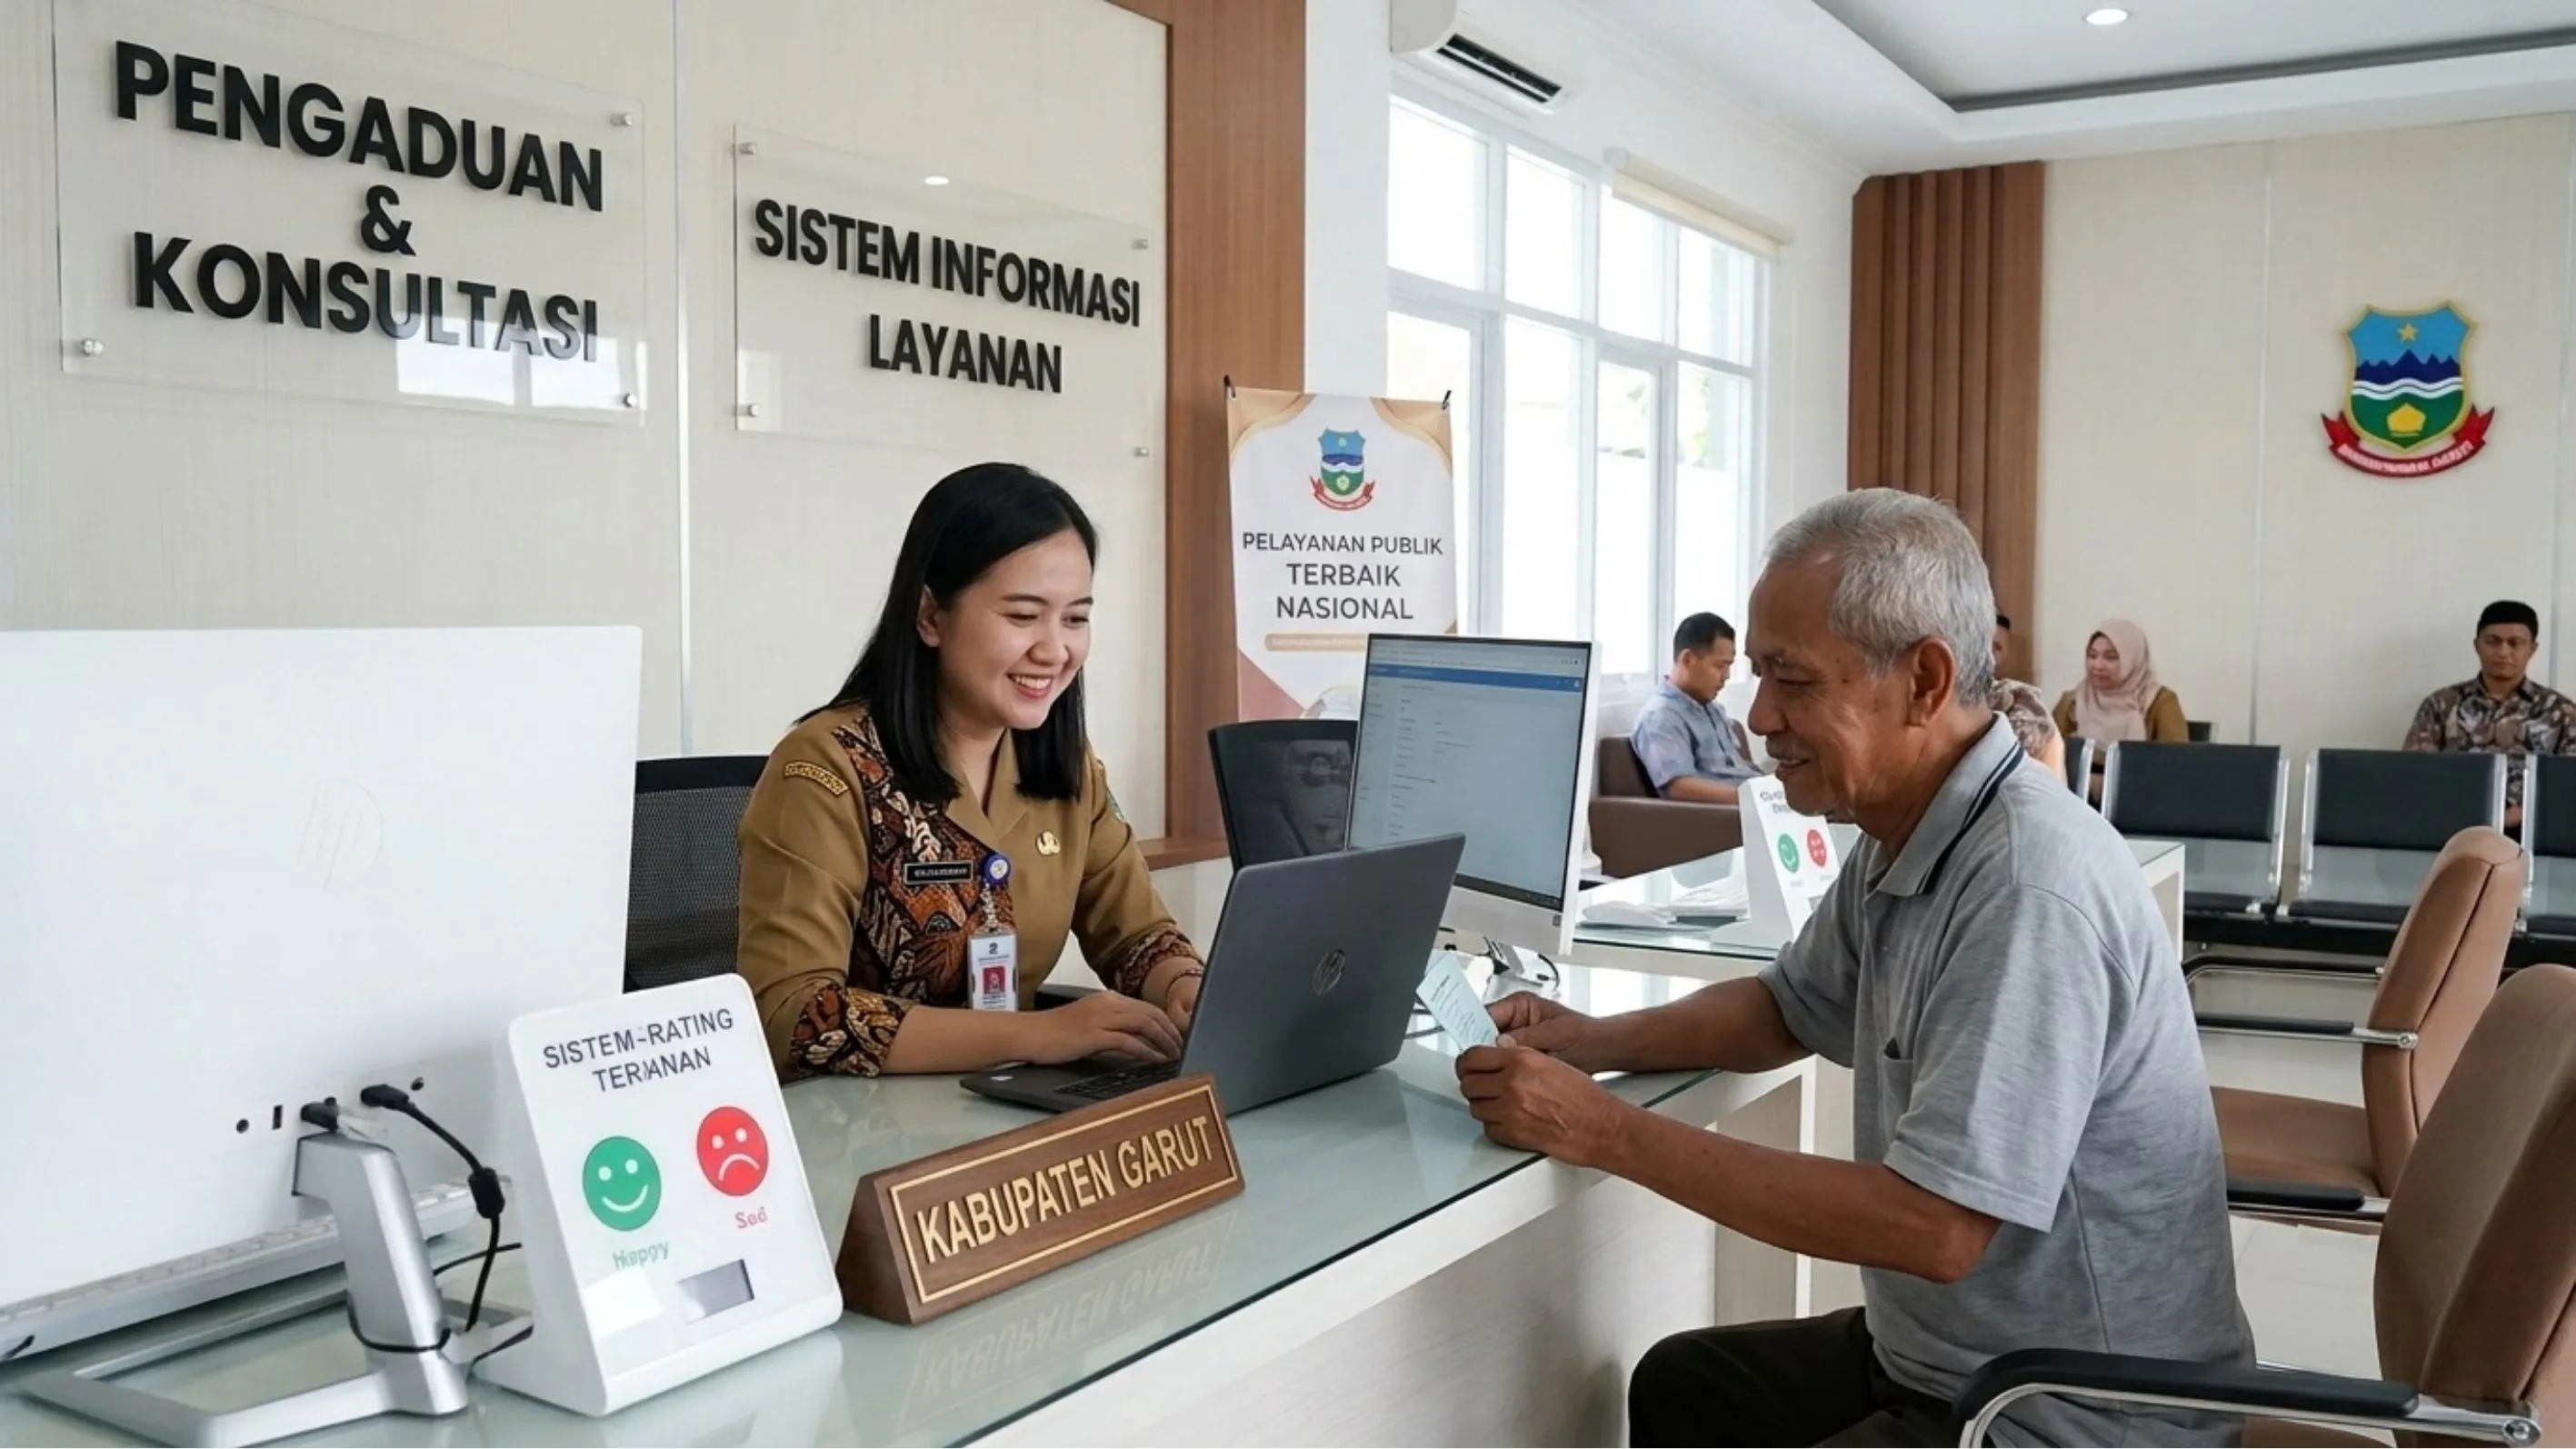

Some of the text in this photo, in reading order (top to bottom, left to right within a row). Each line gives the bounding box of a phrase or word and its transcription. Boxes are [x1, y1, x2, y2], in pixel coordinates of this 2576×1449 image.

[115, 40, 604, 213] PENGADUAN
[359, 185, 417, 256] &
[132, 230, 599, 363] KONSULTASI
[754, 198, 1141, 327] SISTEM INFORMASI
[868, 314, 1063, 395] LAYANAN
[1242, 531, 1444, 555] PELAYANAN PUBLIK
[1285, 562, 1402, 588] TERBAIK
[1275, 595, 1414, 621] NASIONAL
[915, 1115, 1213, 1264] KABUPATEN GARUT
